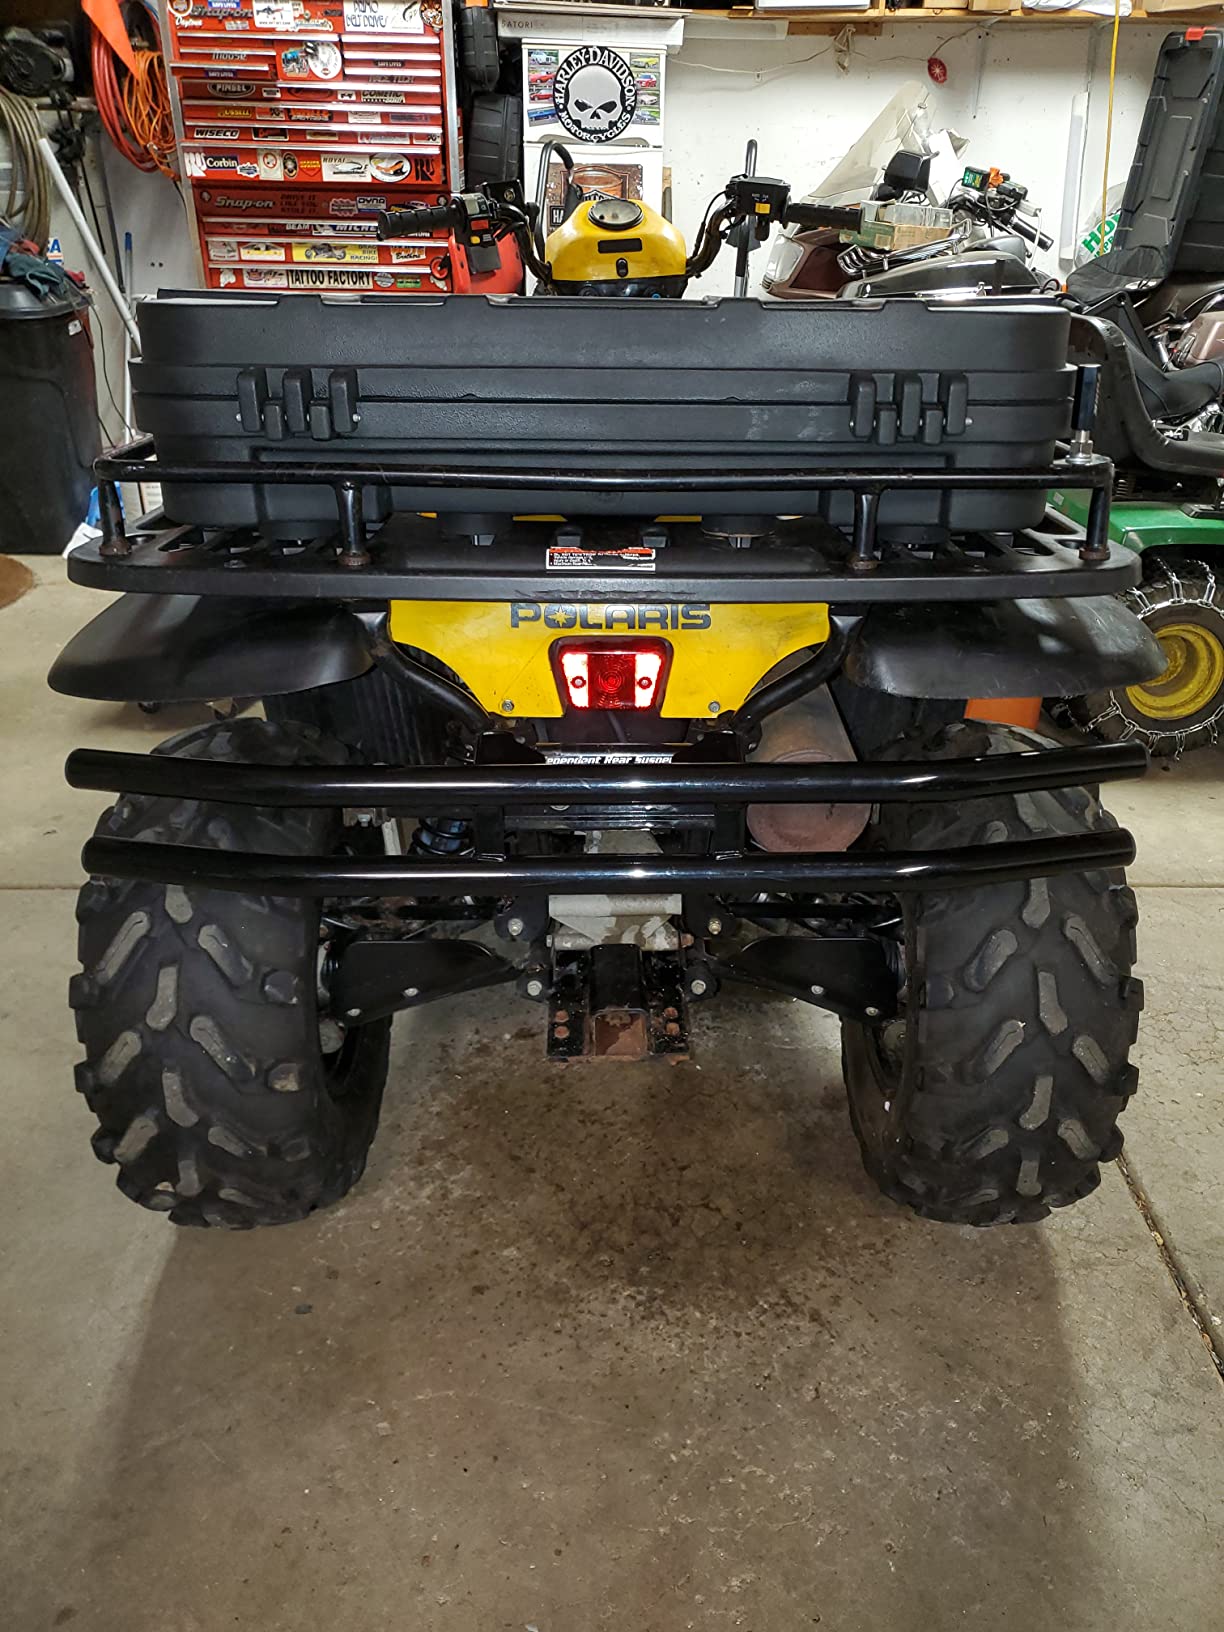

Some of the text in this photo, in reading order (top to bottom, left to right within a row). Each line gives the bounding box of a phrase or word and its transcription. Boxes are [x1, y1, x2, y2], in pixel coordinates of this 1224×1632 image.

[501, 20, 533, 29] SATORI
[554, 46, 636, 107] HARLEY-DAVIDSON
[195, 129, 239, 138] WISECO
[558, 111, 631, 143] MOTORCYCLES
[206, 157, 238, 168] Corbin
[215, 196, 274, 210] Snap-on
[289, 269, 325, 285] TATTOO
[328, 270, 372, 286] FACTORY
[510, 603, 712, 630] POLARIS
[545, 755, 601, 765] ependent
[603, 755, 632, 764] Rear
